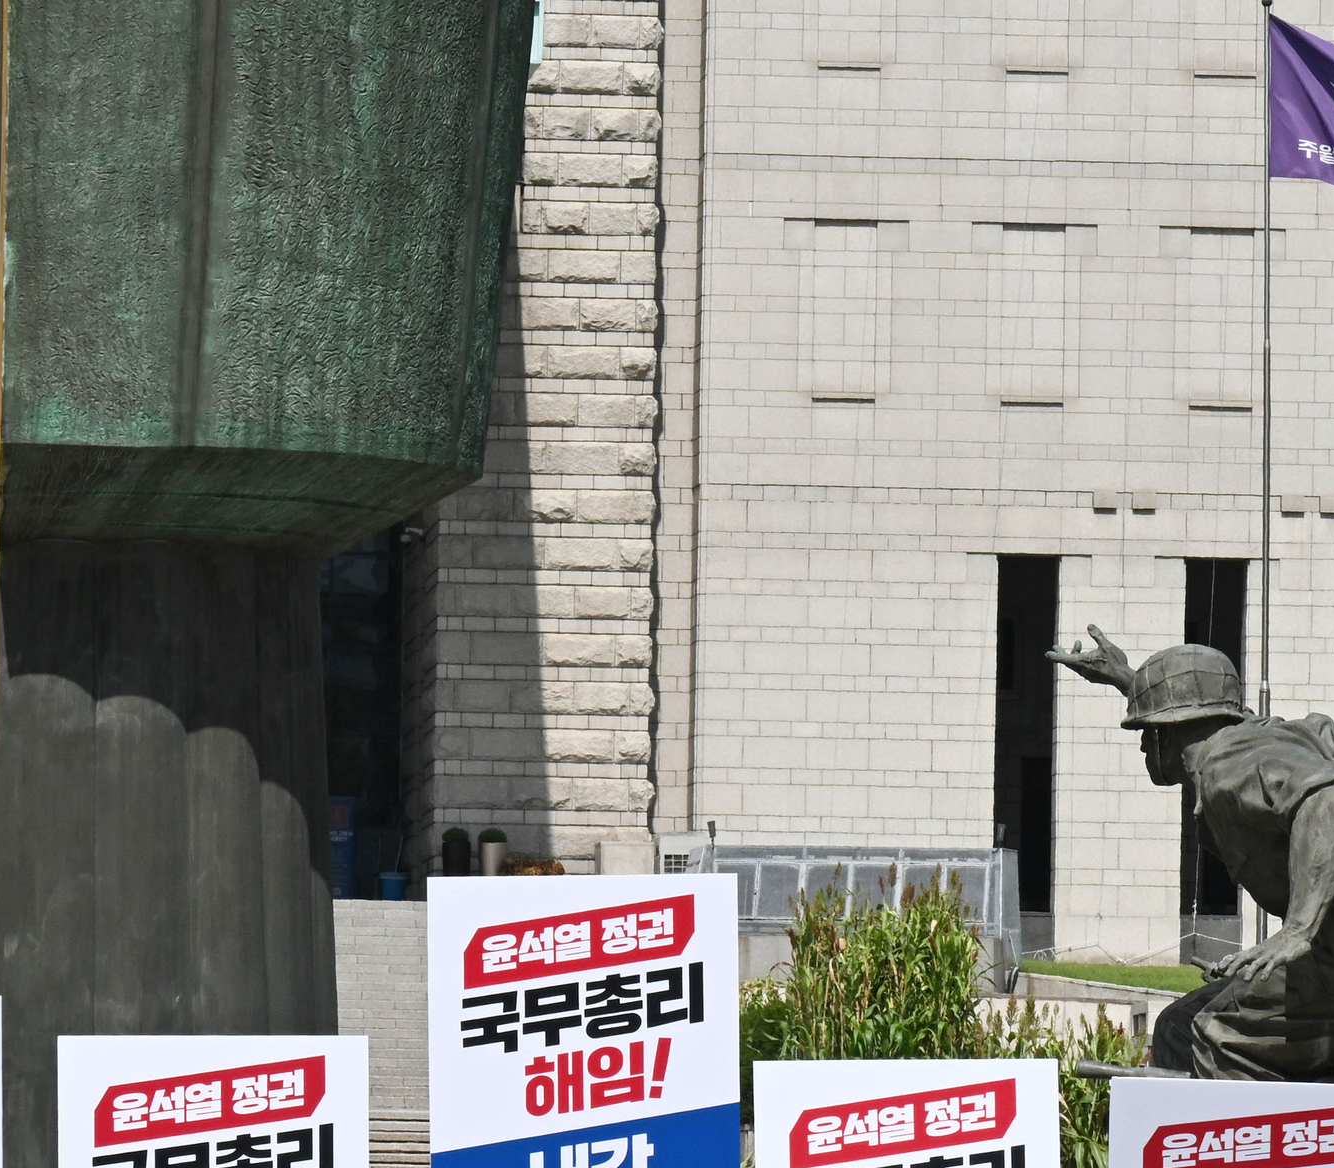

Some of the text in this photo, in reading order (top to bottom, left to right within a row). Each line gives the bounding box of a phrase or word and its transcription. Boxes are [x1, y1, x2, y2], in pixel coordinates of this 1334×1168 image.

[483, 908, 673, 973] 윤석열 정권
[461, 962, 703, 1053] 국무총리
[114, 1069, 304, 1131] 윤석열 정권
[526, 1038, 671, 1116] 해임!
[808, 1091, 995, 1154] 윤석열 정권
[1162, 1124, 1271, 1168] 윤석열
